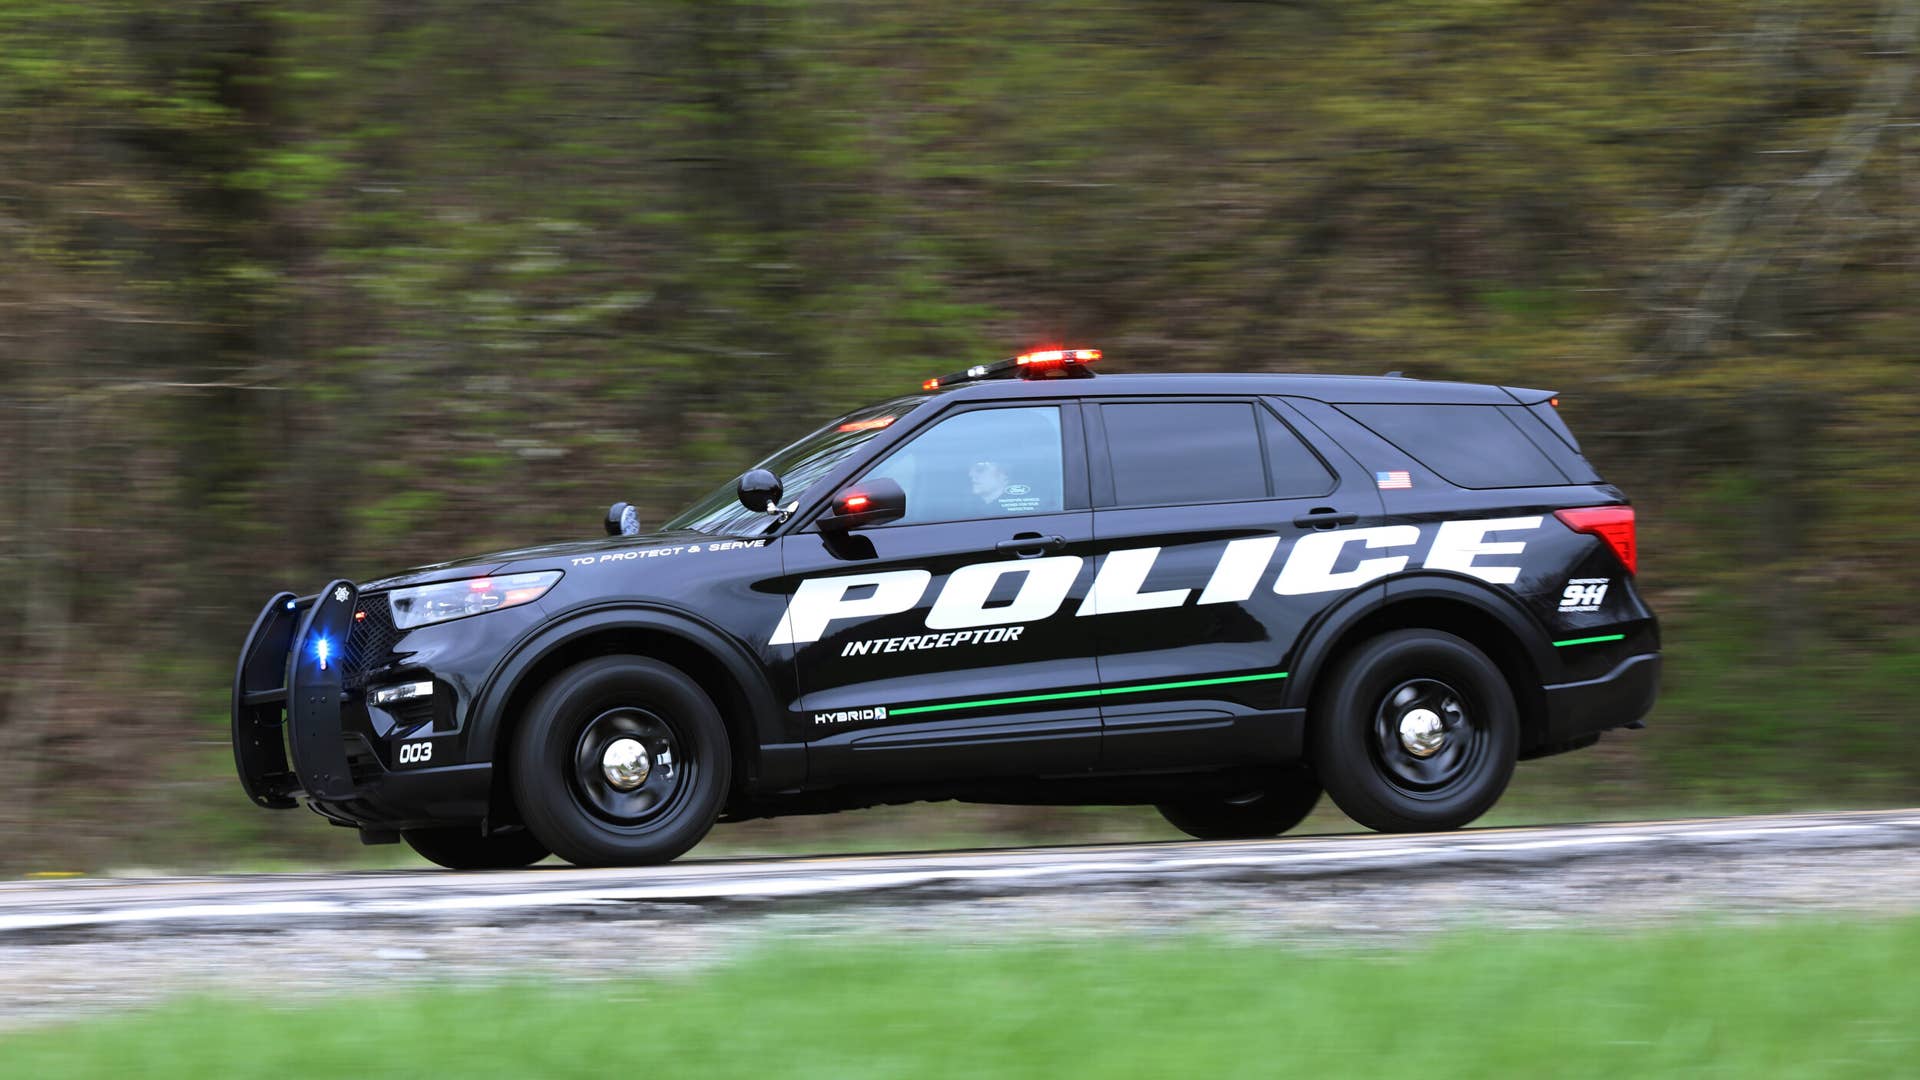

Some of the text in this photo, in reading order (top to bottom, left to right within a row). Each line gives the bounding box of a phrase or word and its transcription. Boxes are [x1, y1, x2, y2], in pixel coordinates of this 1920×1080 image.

[572, 539, 767, 566] TO PROTECT & SERVE
[768, 516, 1543, 645] POLICE
[1560, 584, 1608, 605] 911
[841, 626, 1025, 657] INTERCEPTOR
[815, 709, 874, 724] HYBRID
[400, 742, 433, 763] 003
